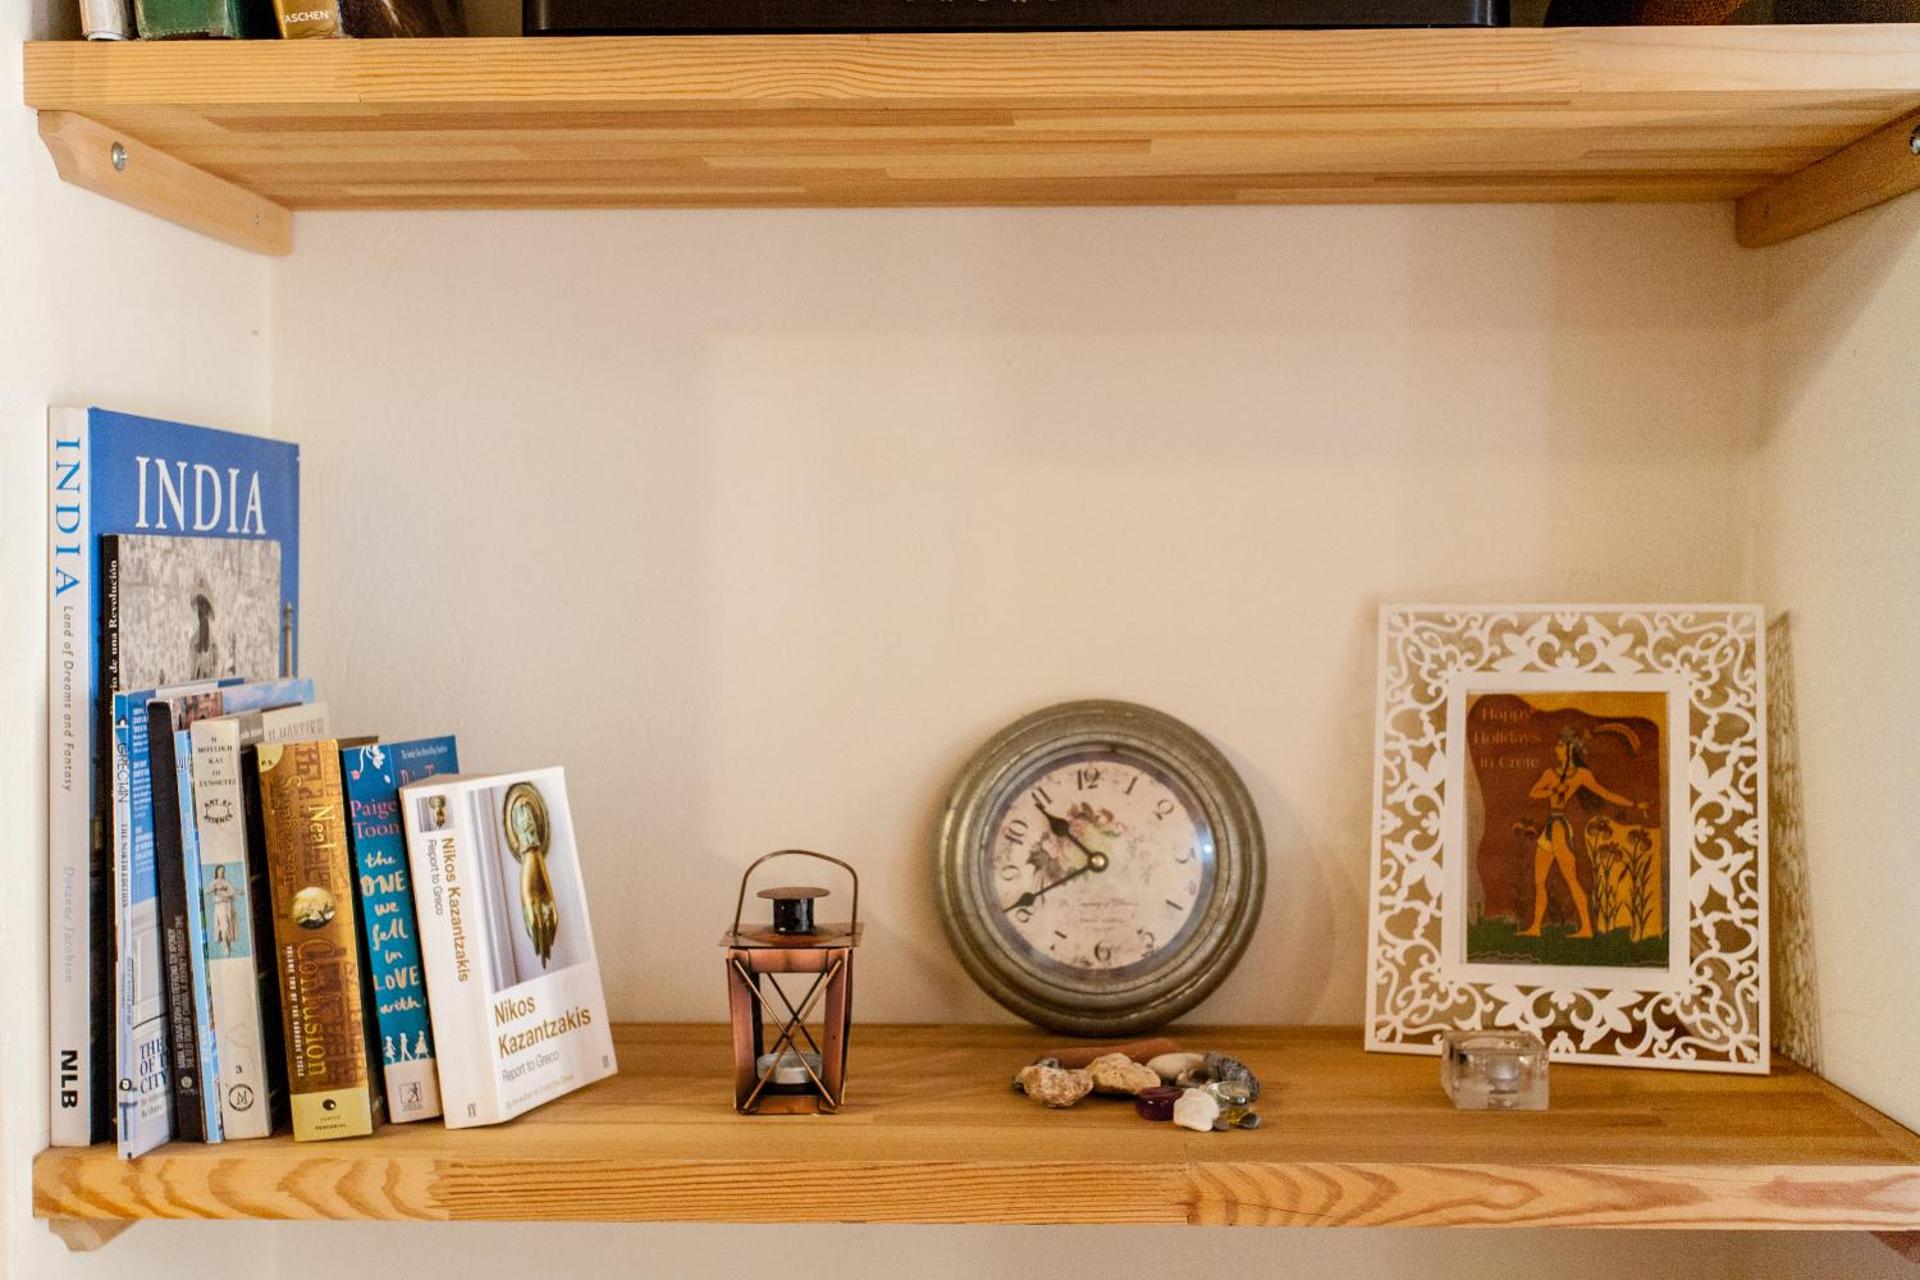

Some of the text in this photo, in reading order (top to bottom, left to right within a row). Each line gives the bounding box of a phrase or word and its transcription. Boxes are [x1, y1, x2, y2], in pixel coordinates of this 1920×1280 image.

[135, 456, 267, 535] INDIA
[56, 437, 81, 597] INDIA
[108, 559, 118, 628] Revolución
[61, 605, 74, 792] Land of Dreams and Fantasy
[1473, 730, 1541, 745] Holidays
[1498, 757, 1541, 770] Crete
[1077, 767, 1100, 790] 12
[1123, 776, 1138, 795] 1
[350, 799, 398, 820] Paige
[1031, 786, 1052, 805] 11
[1154, 799, 1174, 821] 2
[308, 804, 337, 850] Neal
[352, 820, 400, 840] Toon
[1004, 818, 1029, 846] 10
[365, 850, 397, 868] the
[360, 870, 407, 897] ONE
[427, 839, 444, 916] Report to Greco
[374, 901, 400, 917] we
[441, 837, 471, 983] Nikos Kazantzakis
[373, 918, 409, 951] fell
[384, 950, 404, 965] in
[297, 938, 336, 1076] Confusion
[379, 996, 422, 1014] with
[494, 996, 536, 1027] Nikos
[498, 1006, 592, 1059] Kazantzakis
[60, 1050, 79, 1109] NLB
[502, 1050, 560, 1083] Report to Greco
